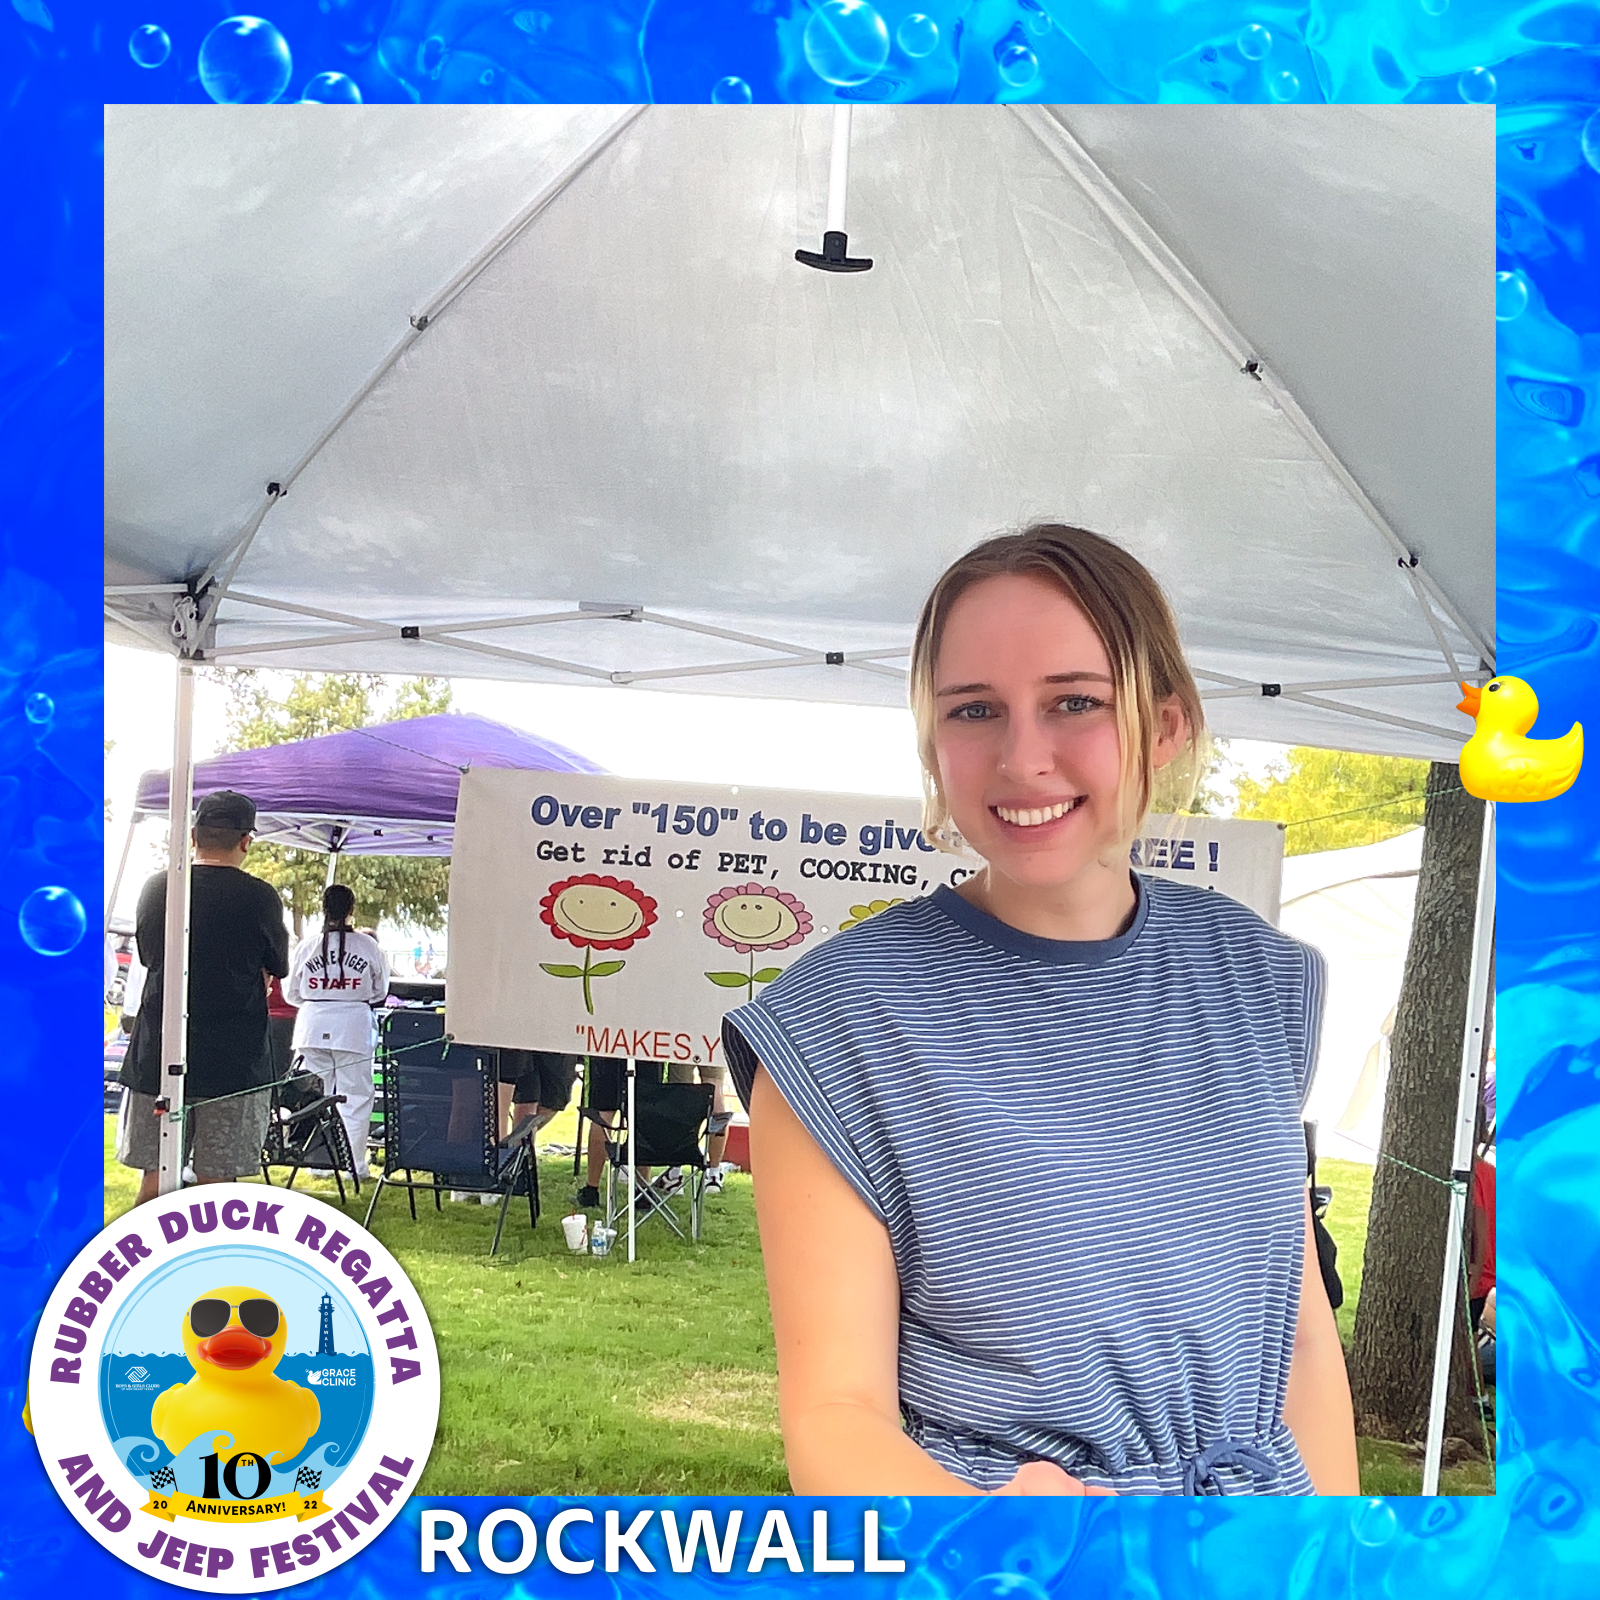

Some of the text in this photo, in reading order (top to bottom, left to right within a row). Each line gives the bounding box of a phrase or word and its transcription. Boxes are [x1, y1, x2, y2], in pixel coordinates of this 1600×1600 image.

[531, 795, 622, 829] Over
[632, 802, 738, 837] "150"
[749, 811, 788, 841] to
[800, 814, 846, 845] be
[537, 840, 586, 862] Get
[602, 845, 651, 867] rid
[668, 850, 701, 870] of
[717, 852, 779, 880] PET,
[799, 858, 929, 890] COOKING,
[308, 977, 361, 990] STAFF
[576, 1025, 691, 1060] "MAKES
